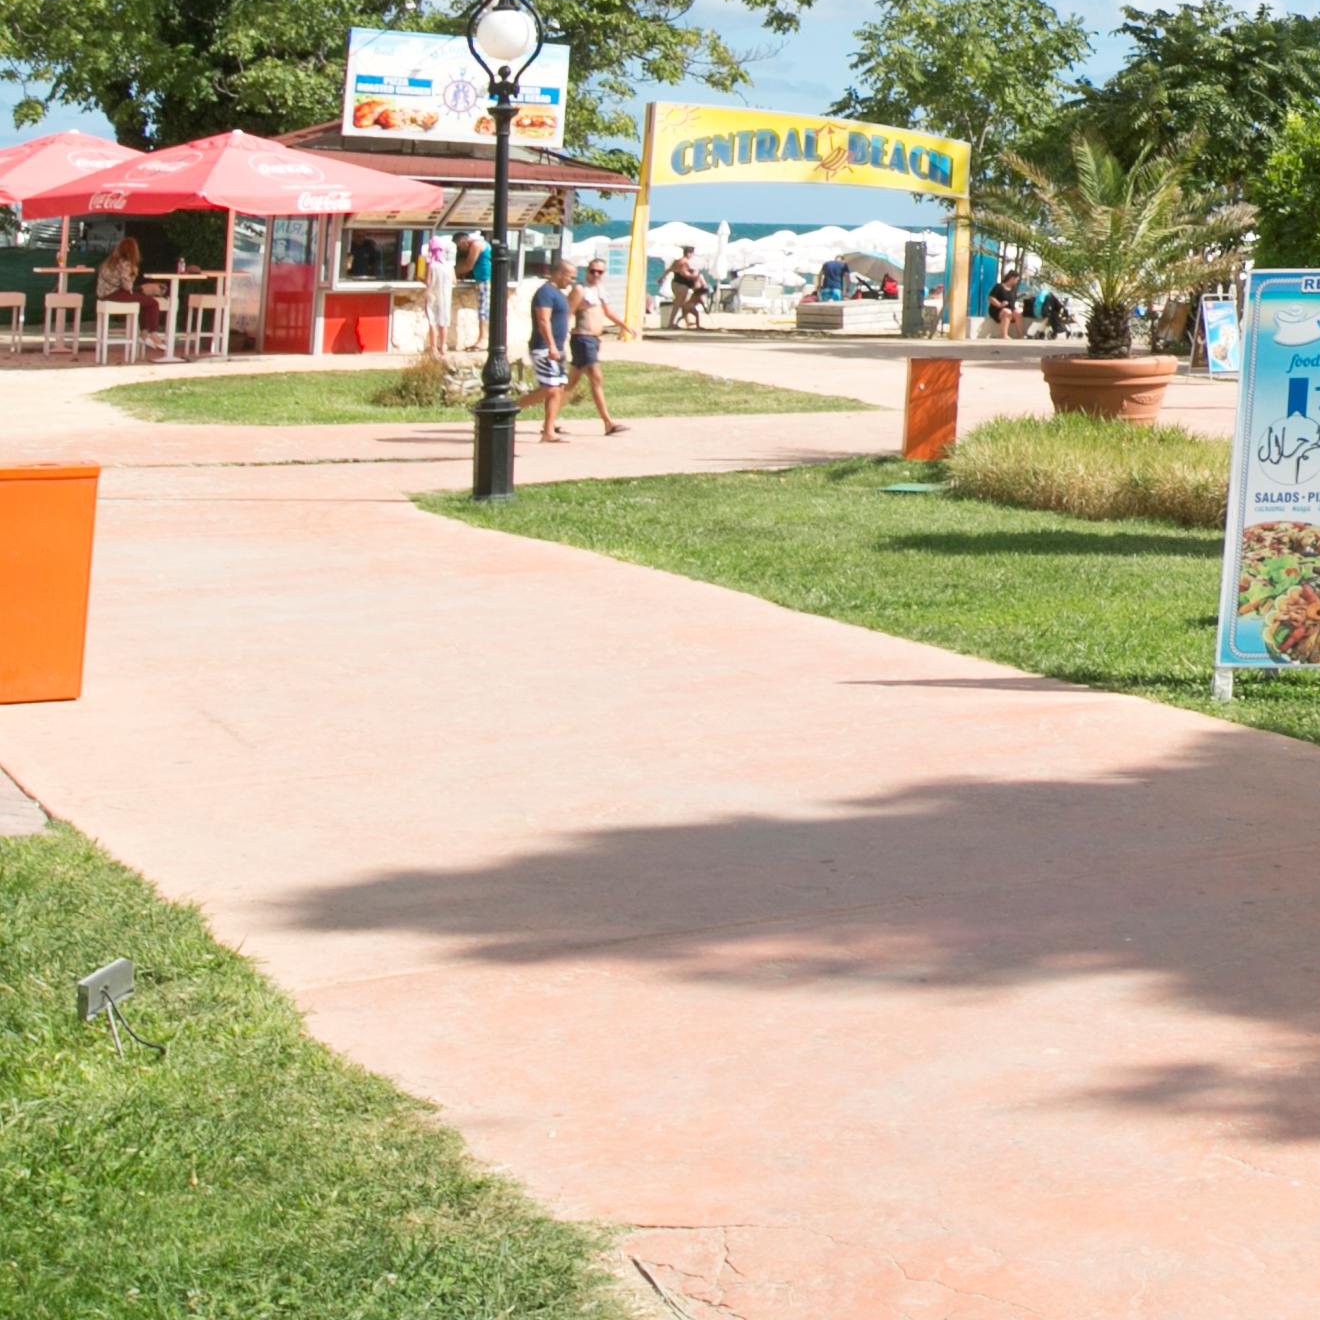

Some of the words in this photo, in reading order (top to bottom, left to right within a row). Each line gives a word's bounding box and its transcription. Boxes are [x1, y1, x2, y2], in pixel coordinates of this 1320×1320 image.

[671, 128, 823, 176] CENTRAL
[847, 130, 953, 188] BEACH
[1286, 353, 1320, 373] food
[1254, 491, 1300, 504] SALADS
